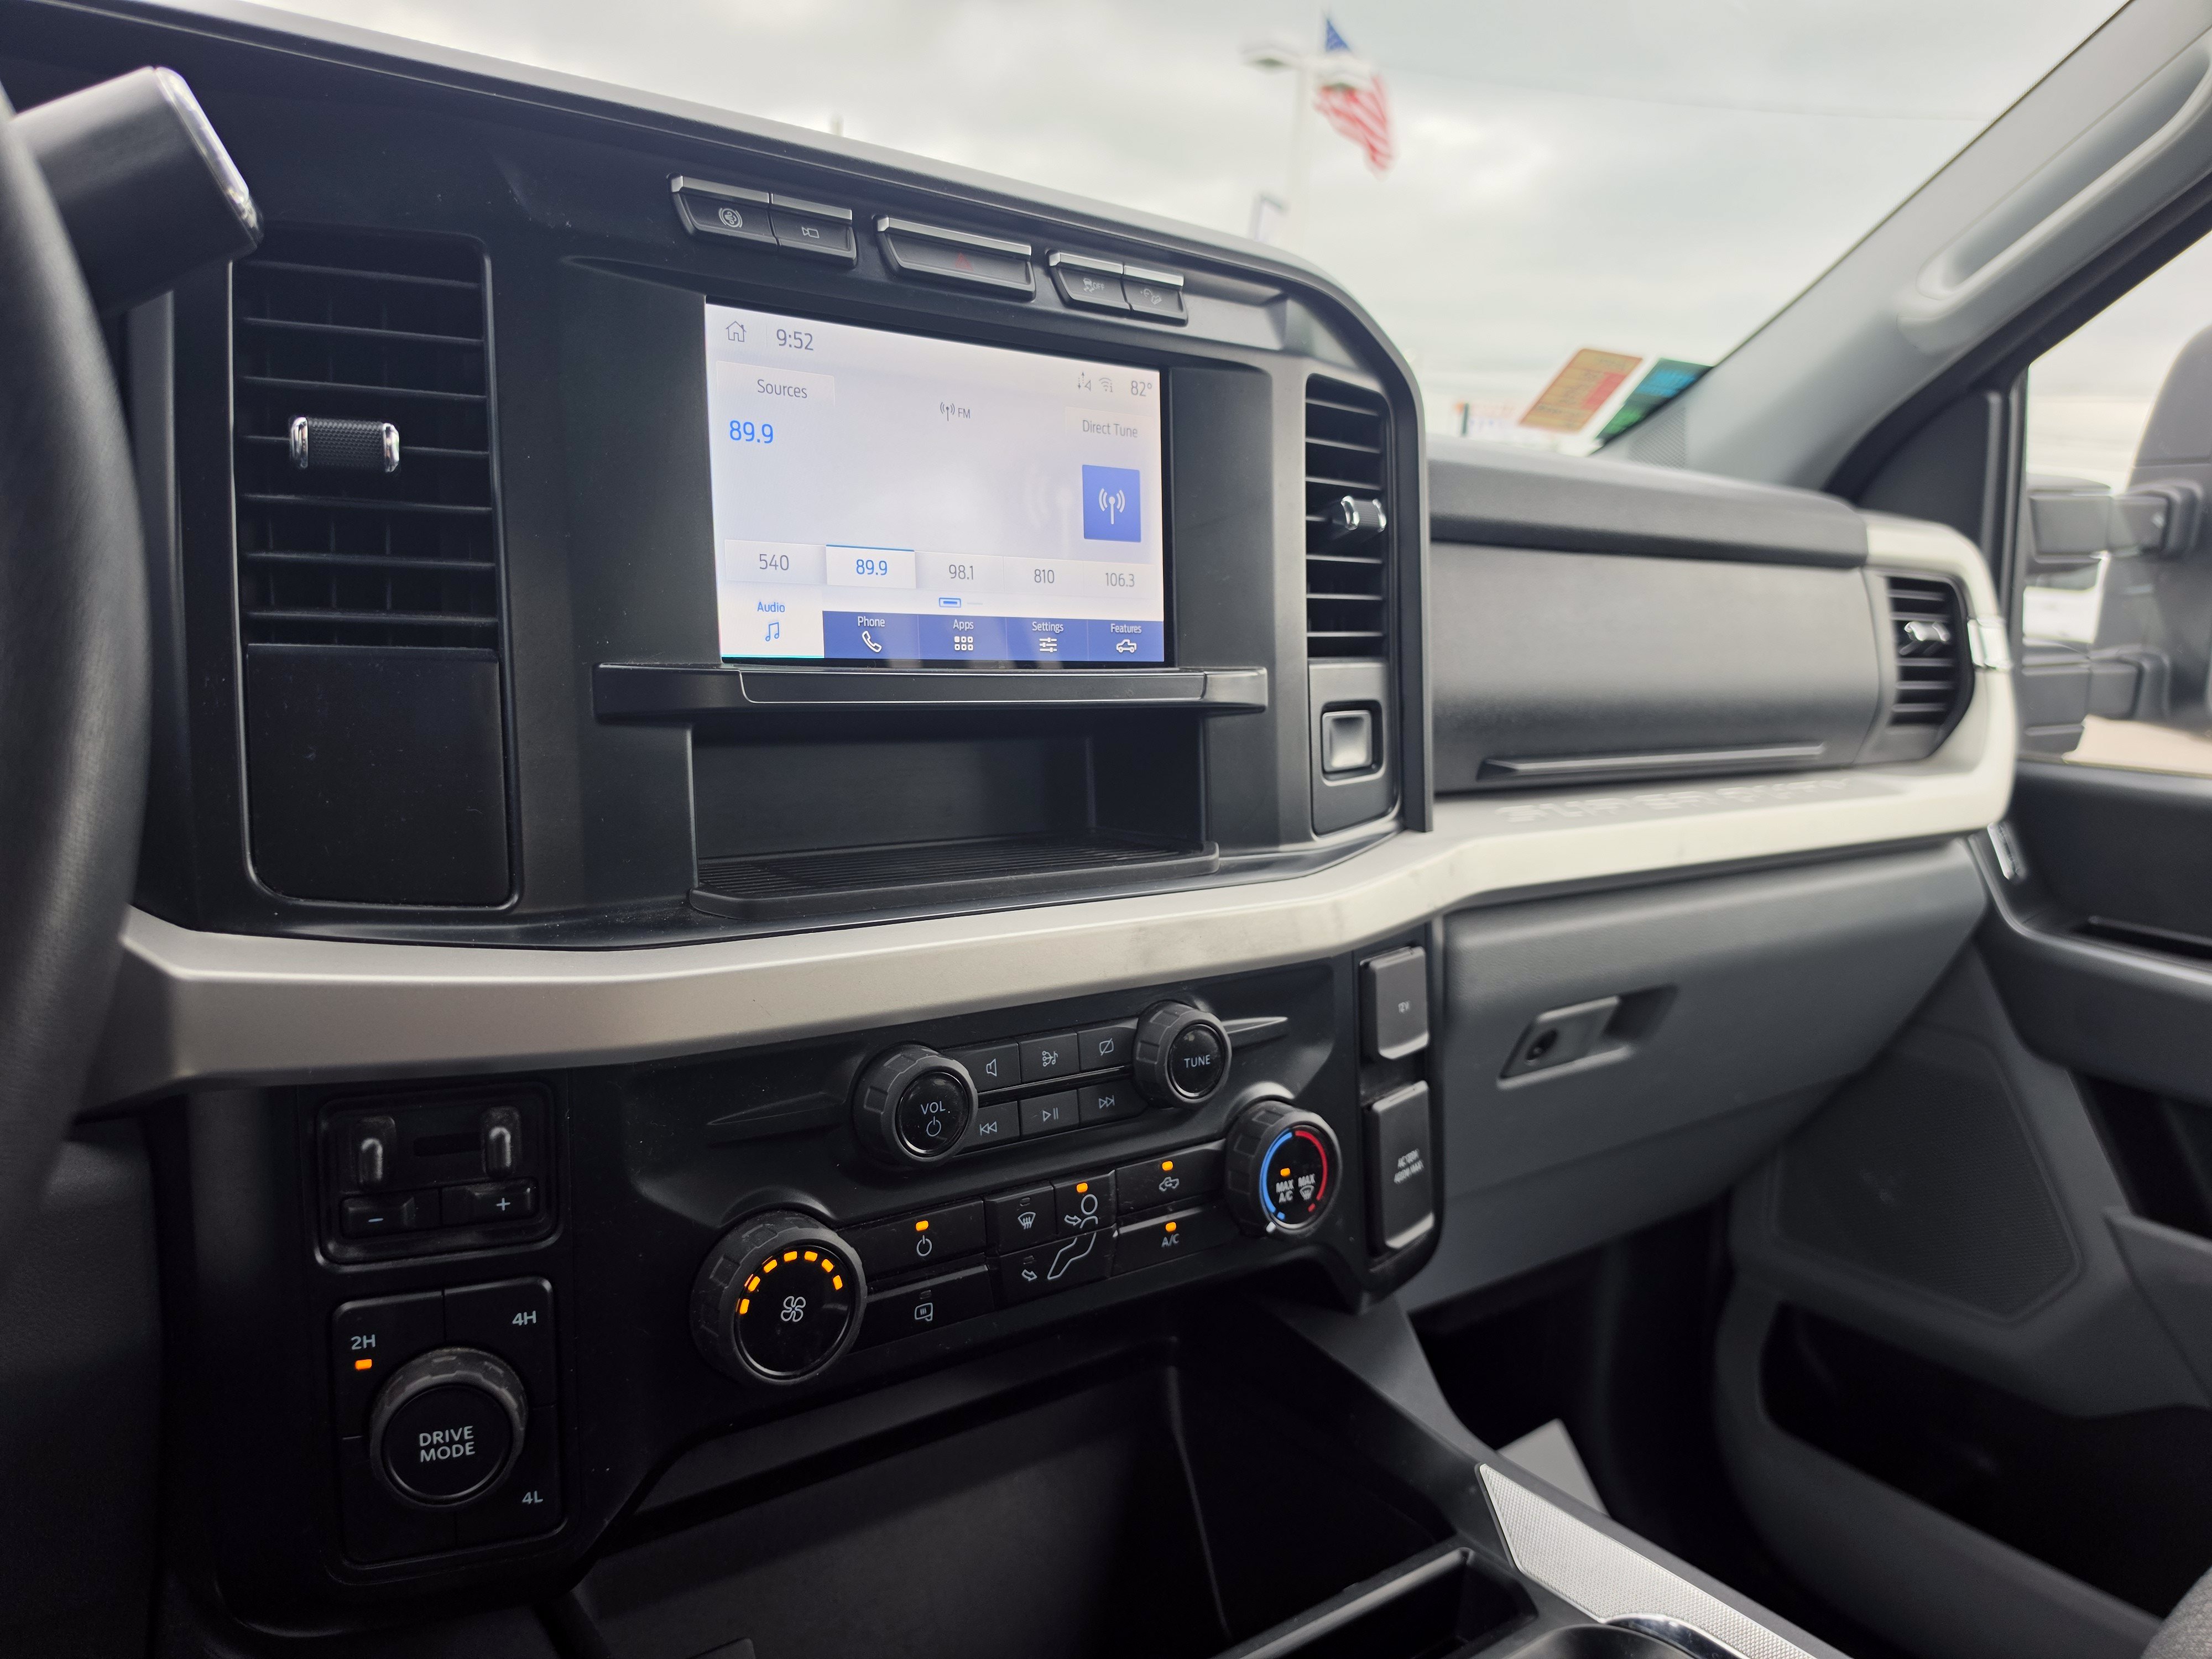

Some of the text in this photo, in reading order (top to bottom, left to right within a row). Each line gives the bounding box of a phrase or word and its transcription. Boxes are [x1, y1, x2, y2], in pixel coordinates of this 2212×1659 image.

[1093, 281, 1105, 291] OFF
[776, 328, 814, 351] 9:52
[757, 379, 808, 399] Sources
[1130, 380, 1152, 397] 82°
[958, 408, 971, 419] FM
[729, 419, 774, 444] 89.9
[1082, 419, 1138, 439] Direct Tune
[759, 554, 790, 571] 540
[855, 559, 888, 576] 89.9
[948, 564, 974, 581] 98.1
[1034, 568, 1055, 584] 810
[1105, 572, 1135, 588] 106.3
[757, 601, 786, 613] Audio
[857, 615, 886, 628] Phone
[953, 618, 974, 631] Apps
[1031, 621, 1065, 633] Settings
[1110, 623, 1142, 634] Features
[1183, 1054, 1211, 1068] TUNE
[920, 1100, 946, 1115] VOL
[1276, 1179, 1294, 1193] MAX
[1298, 1173, 1316, 1187] MAX
[1161, 1233, 1180, 1248] A/C
[512, 1310, 537, 1326] 4H
[350, 1334, 376, 1350] 2H
[419, 1425, 474, 1447] DRIVE
[420, 1441, 476, 1463] MODE
[521, 1490, 544, 1505] 4L
